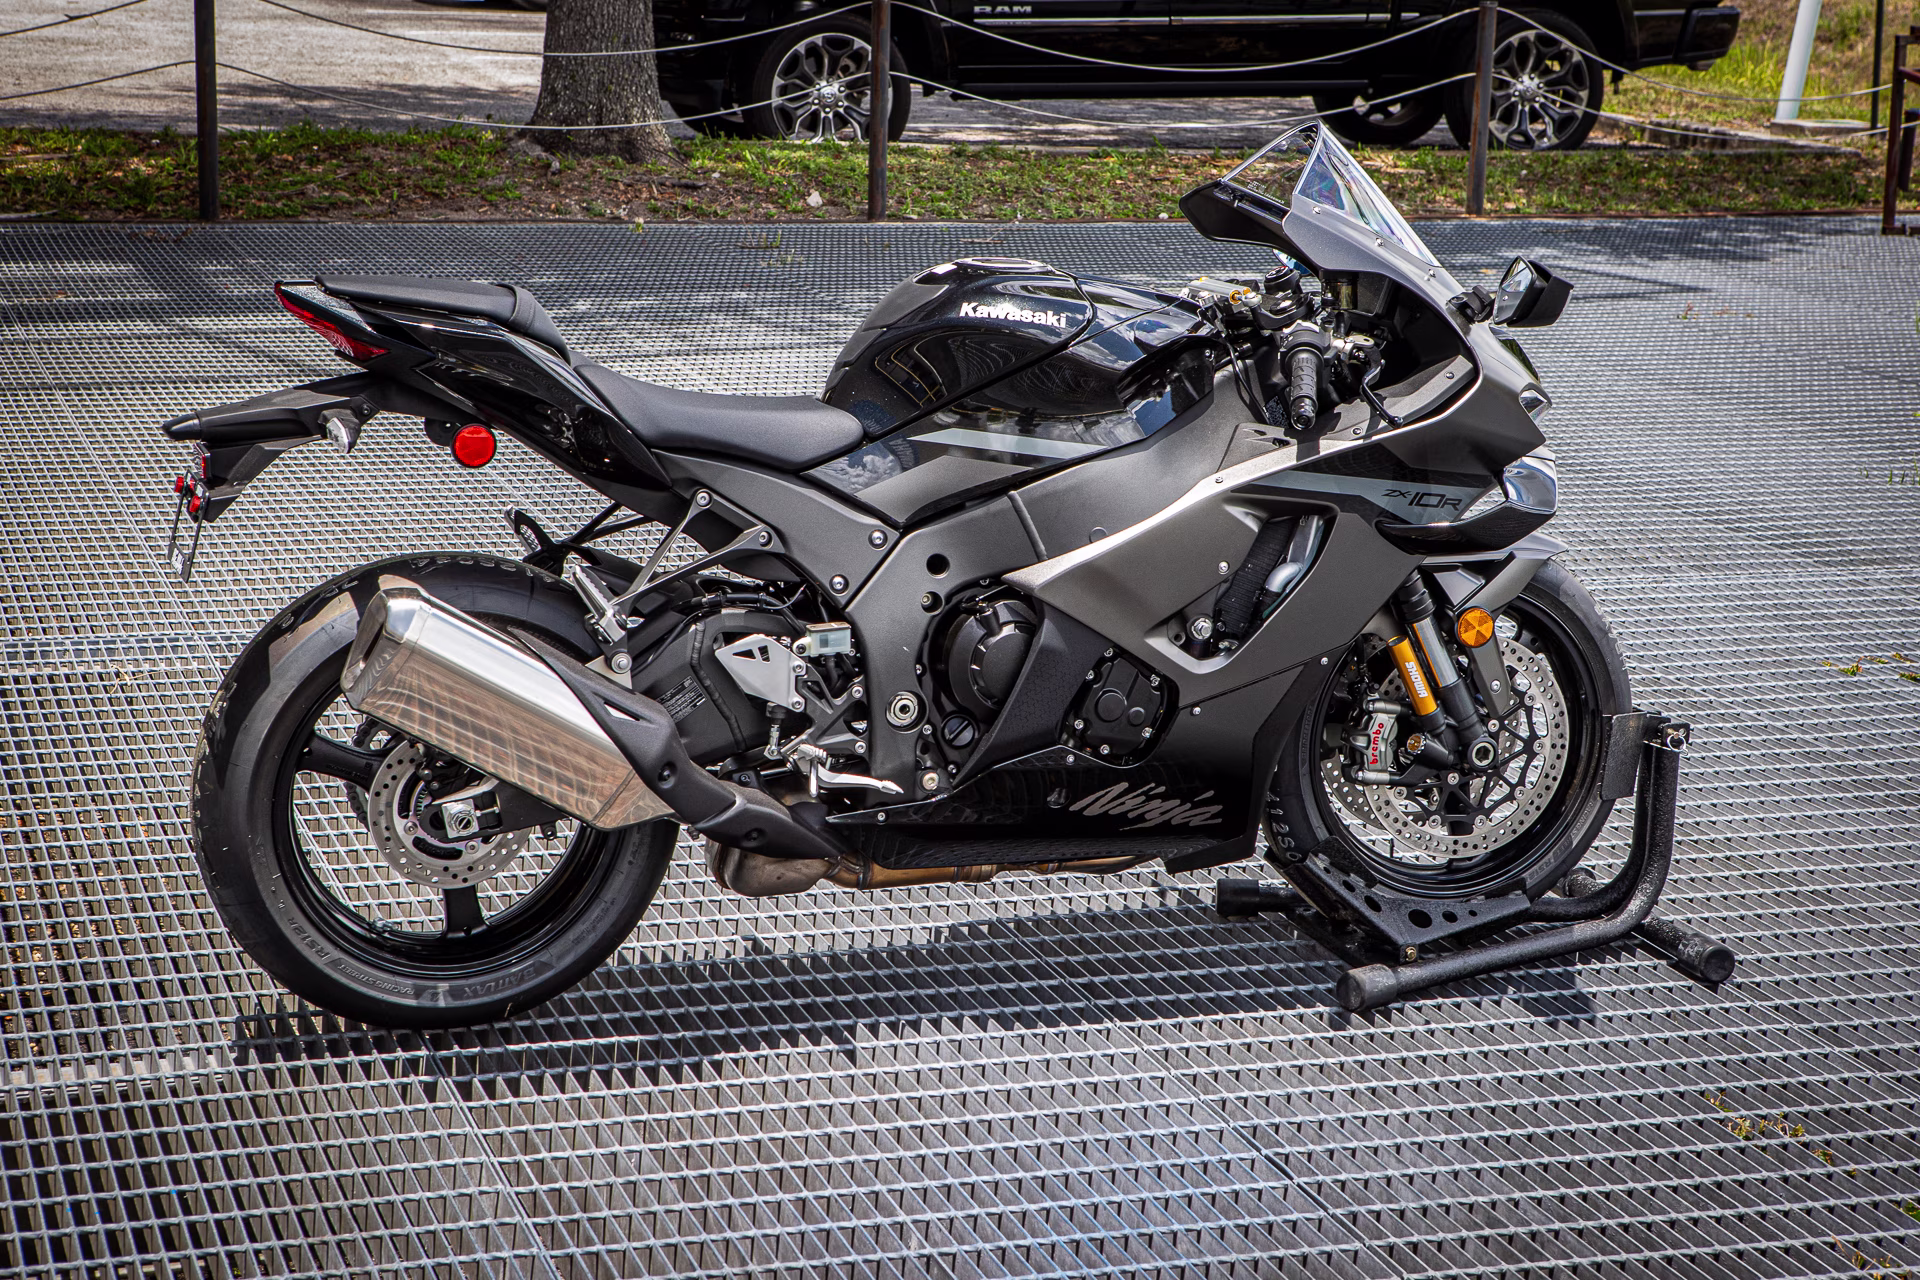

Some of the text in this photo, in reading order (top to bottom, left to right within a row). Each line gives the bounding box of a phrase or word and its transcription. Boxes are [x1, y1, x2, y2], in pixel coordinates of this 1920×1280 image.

[973, 5, 1032, 14] RAM
[960, 302, 1067, 329] Kawasaki
[1405, 661, 1428, 698] SHOWA
[1369, 722, 1384, 765] brembo
[1068, 782, 1224, 831] Ninja
[1527, 857, 1555, 881] RS12
[287, 916, 331, 961] RS12R
[337, 963, 416, 995] RACING STREET
[463, 966, 536, 998] BATTLAX
